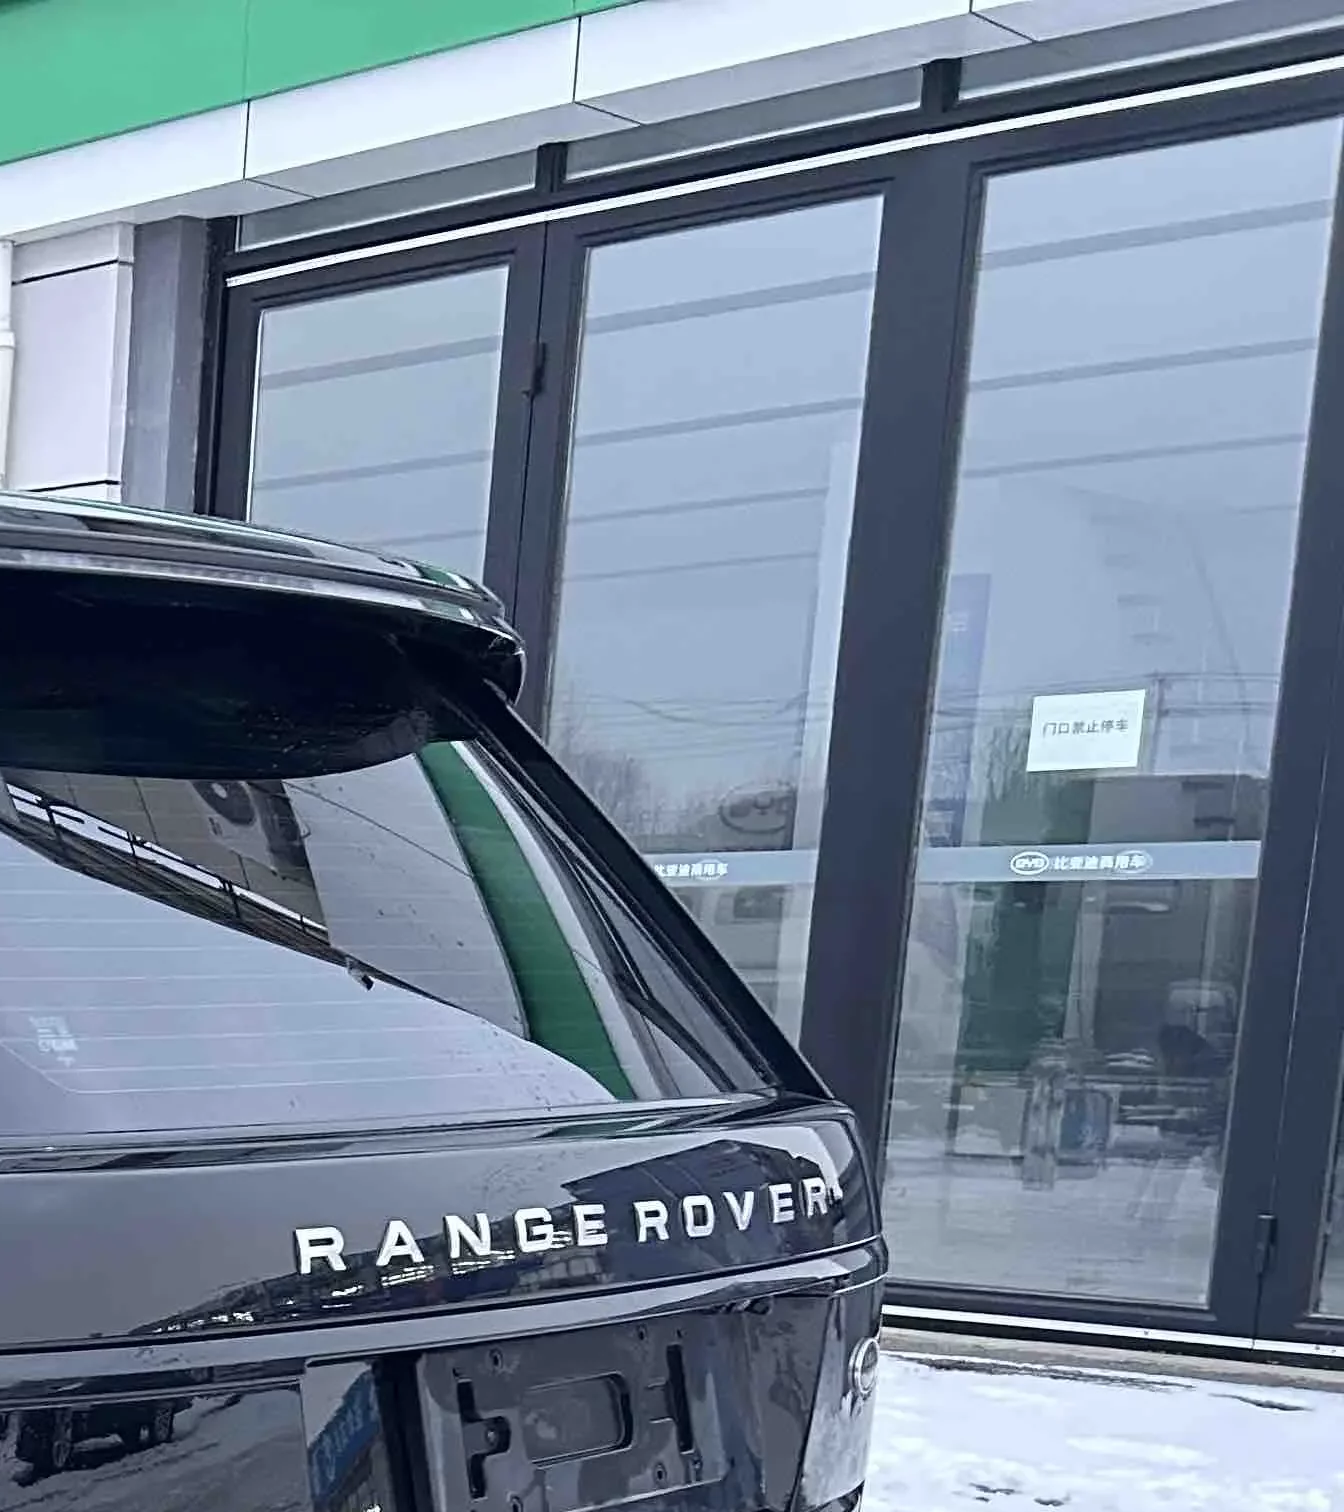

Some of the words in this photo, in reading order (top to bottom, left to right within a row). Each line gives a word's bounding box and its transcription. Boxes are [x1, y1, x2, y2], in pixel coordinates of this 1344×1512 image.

[1042, 718, 1129, 737] 门口禁止停车
[295, 1204, 609, 1273] RANGE
[633, 1177, 830, 1243] ROVER
